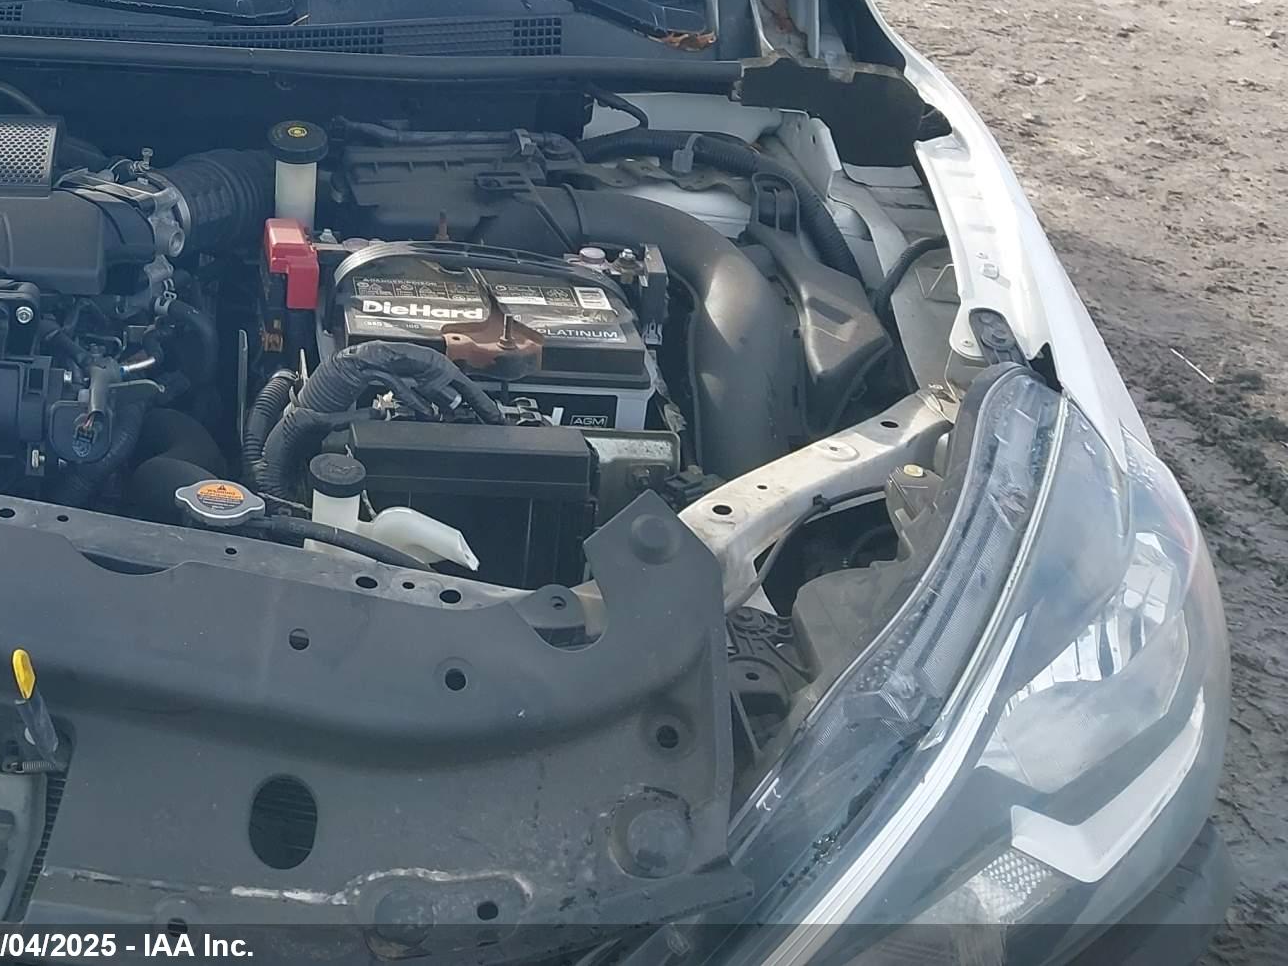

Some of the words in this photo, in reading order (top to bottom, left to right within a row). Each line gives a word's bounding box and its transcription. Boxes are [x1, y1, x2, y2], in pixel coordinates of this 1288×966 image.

[362, 299, 483, 320] DieHard
[536, 328, 618, 339] PLATINUM
[573, 417, 605, 425] AGM
